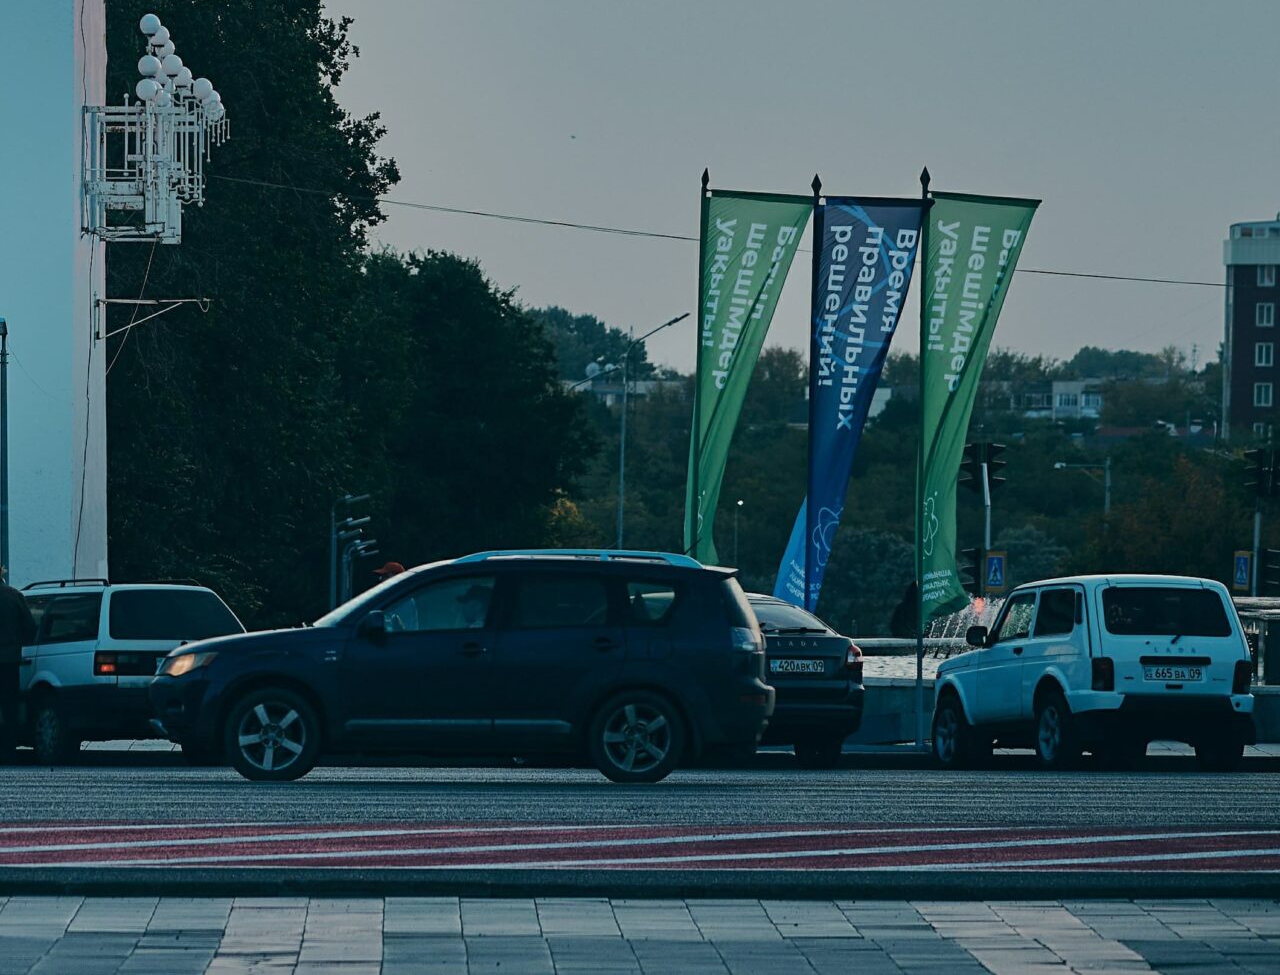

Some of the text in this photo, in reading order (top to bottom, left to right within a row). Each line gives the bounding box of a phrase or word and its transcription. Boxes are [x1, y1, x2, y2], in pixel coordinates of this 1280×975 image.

[701, 218, 738, 348] уақыты!
[712, 222, 767, 390] шешімдер
[817, 225, 853, 387] решений!
[836, 226, 885, 431] правильных
[880, 228, 918, 333] Время
[926, 220, 961, 351] уақыты!
[943, 226, 991, 393] шешімдер
